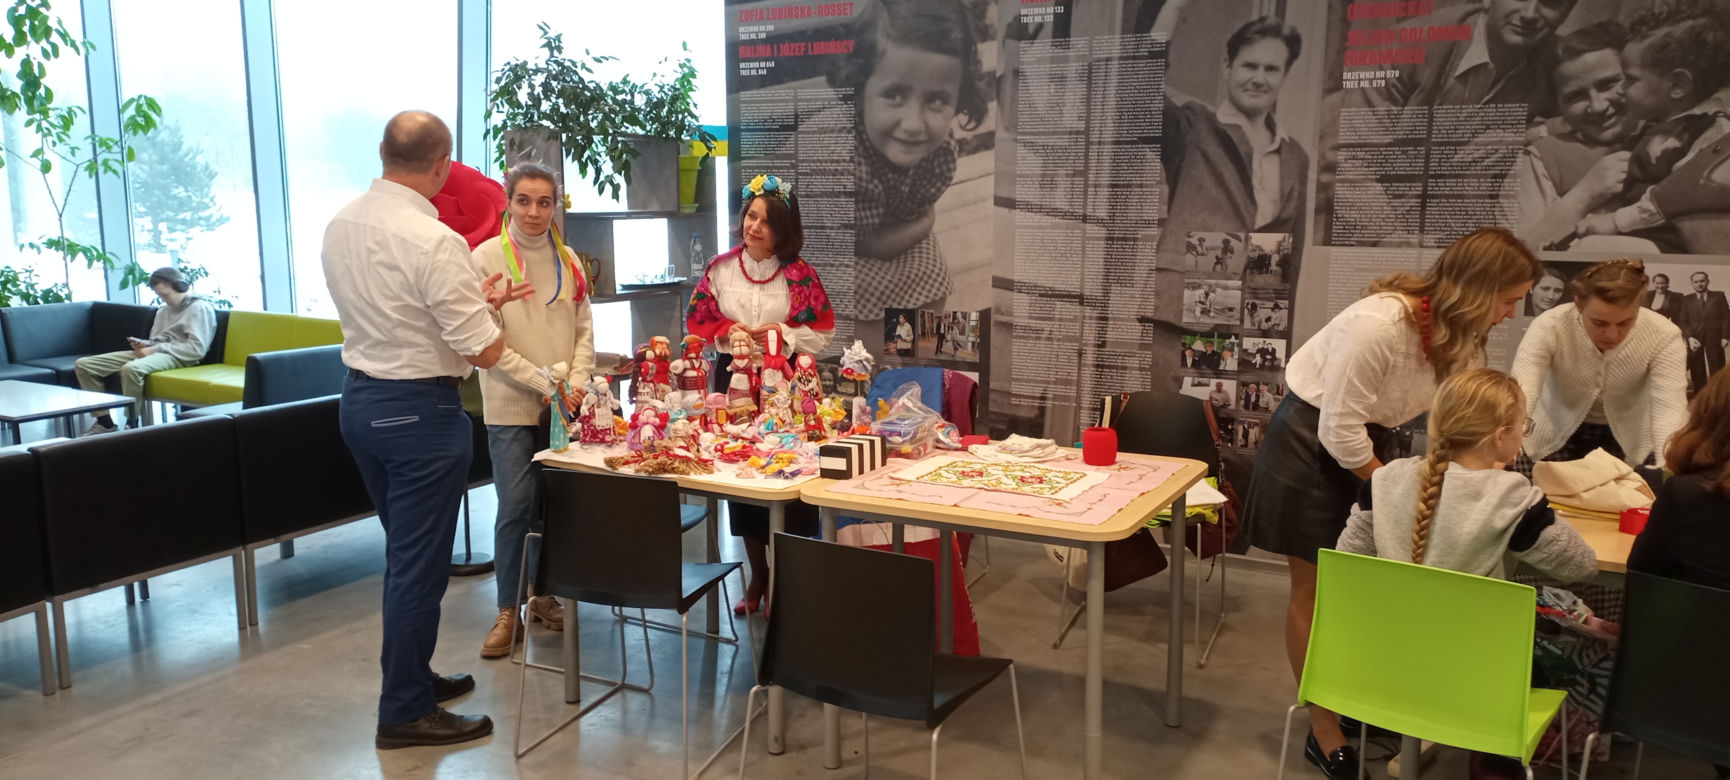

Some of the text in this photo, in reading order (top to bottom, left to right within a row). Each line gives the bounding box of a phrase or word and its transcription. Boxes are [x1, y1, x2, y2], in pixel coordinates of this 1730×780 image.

[739, 2, 855, 22] ZOFIA LUBIŃSKA-ROSSET
[739, 44, 772, 58] HALINA
[779, 40, 806, 56] JÓZEF
[808, 38, 856, 55] LUBIŃSCY
[1342, 70, 1400, 79] DRZEWKO NR 579
[1342, 79, 1385, 88] TREE NO. 579
